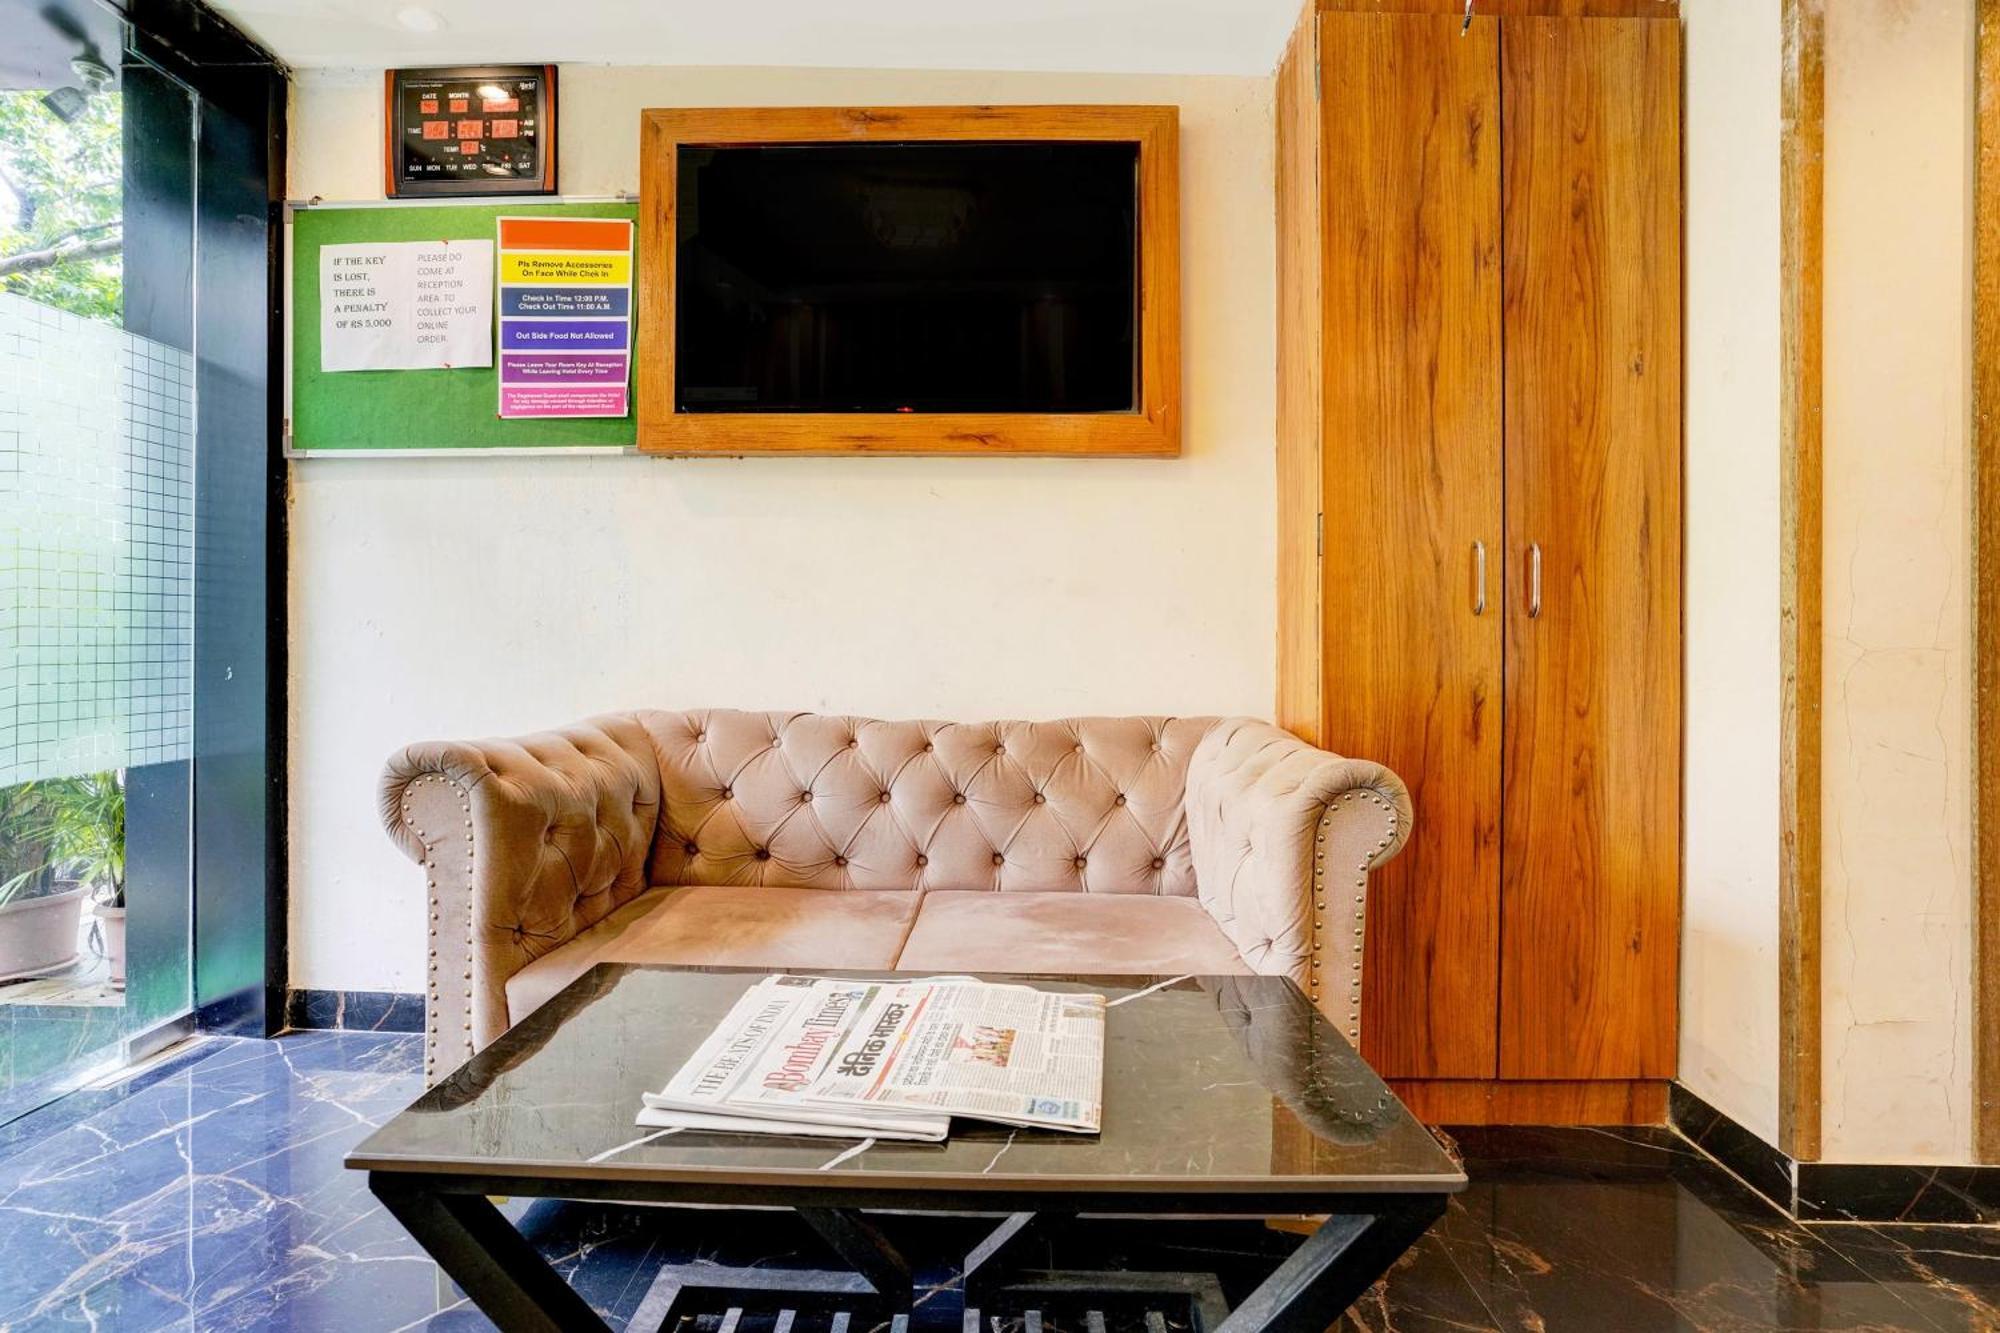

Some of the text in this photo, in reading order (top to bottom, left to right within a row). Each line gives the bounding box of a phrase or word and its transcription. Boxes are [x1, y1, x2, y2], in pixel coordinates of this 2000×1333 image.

[463, 163, 477, 171] WED
[334, 256, 386, 266] IF THE KEY
[418, 253, 462, 262] PLEASE DO
[334, 272, 370, 282] IS LOST,
[418, 280, 464, 289] RECEPTION
[335, 287, 376, 297] THERE IS
[418, 294, 456, 302] AREA TO
[334, 302, 388, 313] A PENALTY
[417, 306, 477, 317] COLLECT YOUR
[336, 320, 347, 329] OF
[351, 319, 363, 328] RS
[417, 321, 448, 330] ONLINE
[801, 992, 852, 1028] Times
[837, 1003, 909, 1077] दैनिक भास्कर
[692, 1073, 727, 1096] THE
[744, 1022, 767, 1041] OF
